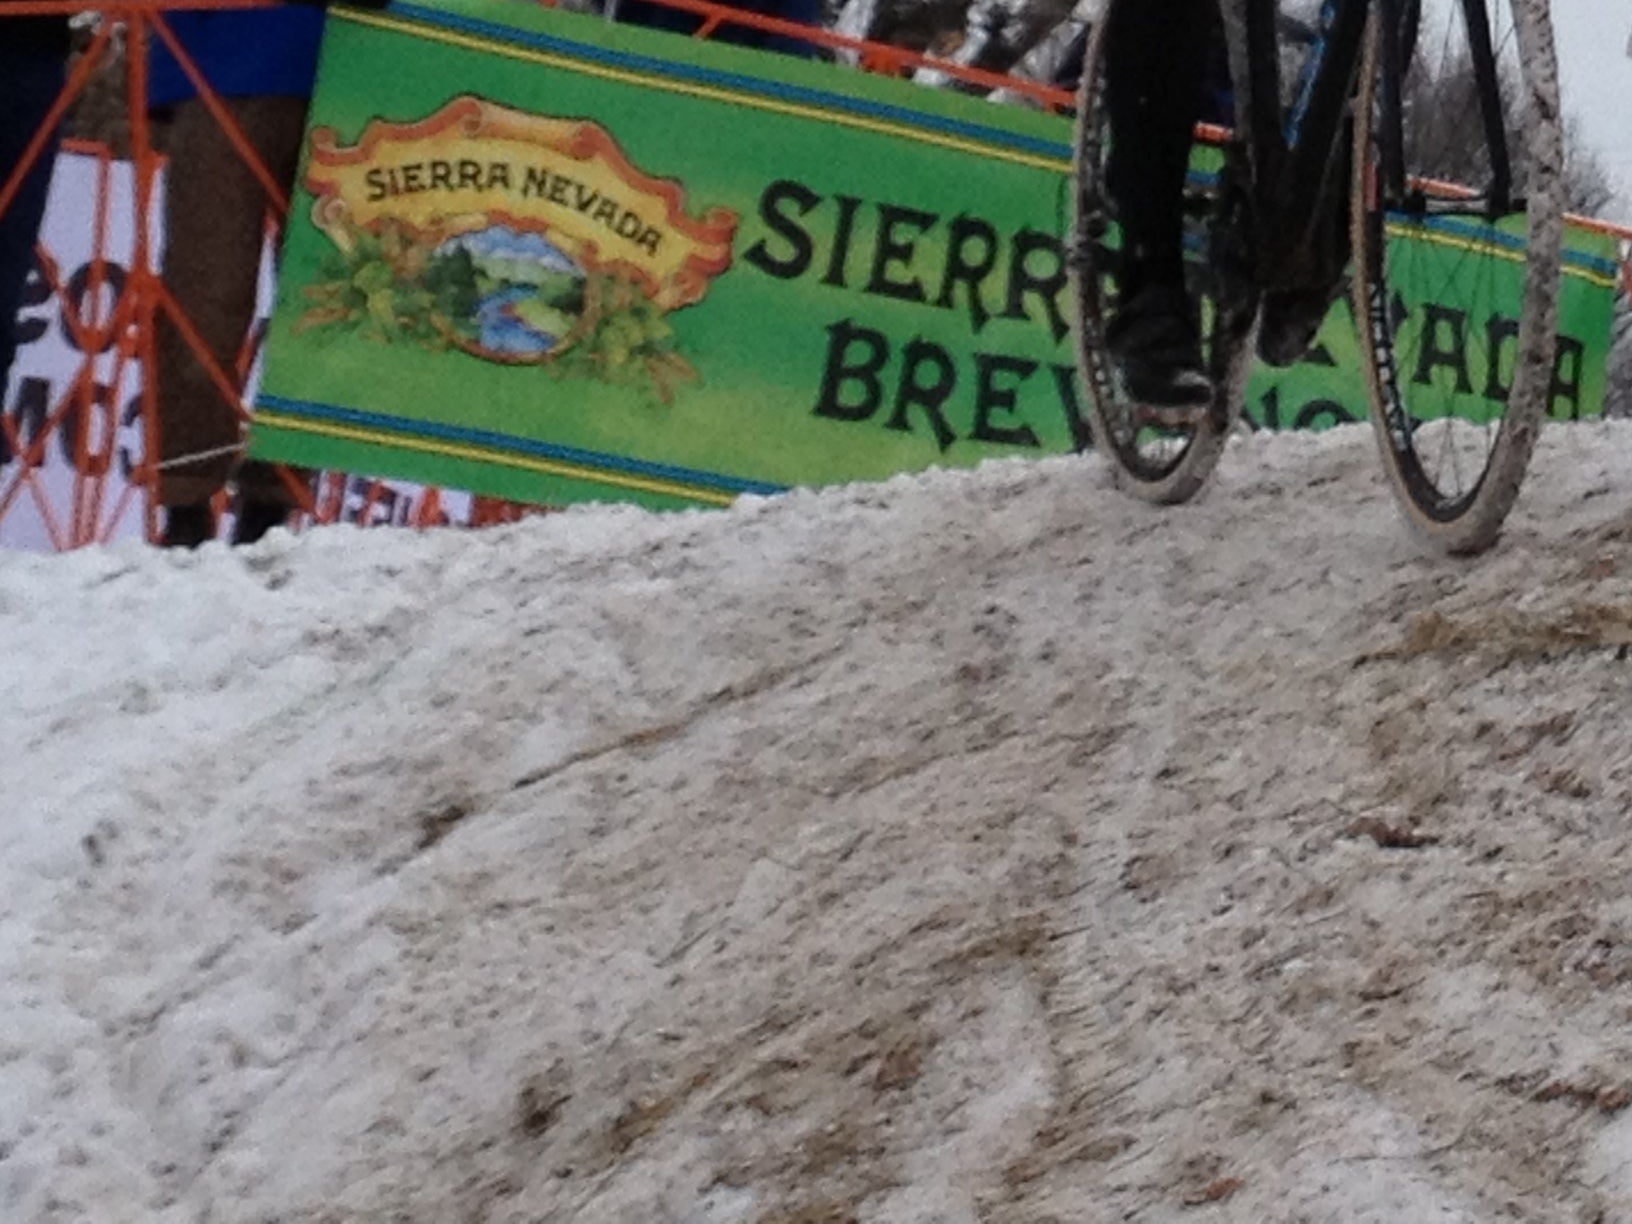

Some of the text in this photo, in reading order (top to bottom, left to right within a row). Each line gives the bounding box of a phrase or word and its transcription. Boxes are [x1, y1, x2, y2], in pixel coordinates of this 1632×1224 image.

[365, 160, 663, 257] SIERRA NEVADA
[742, 178, 1080, 347] SIERR
